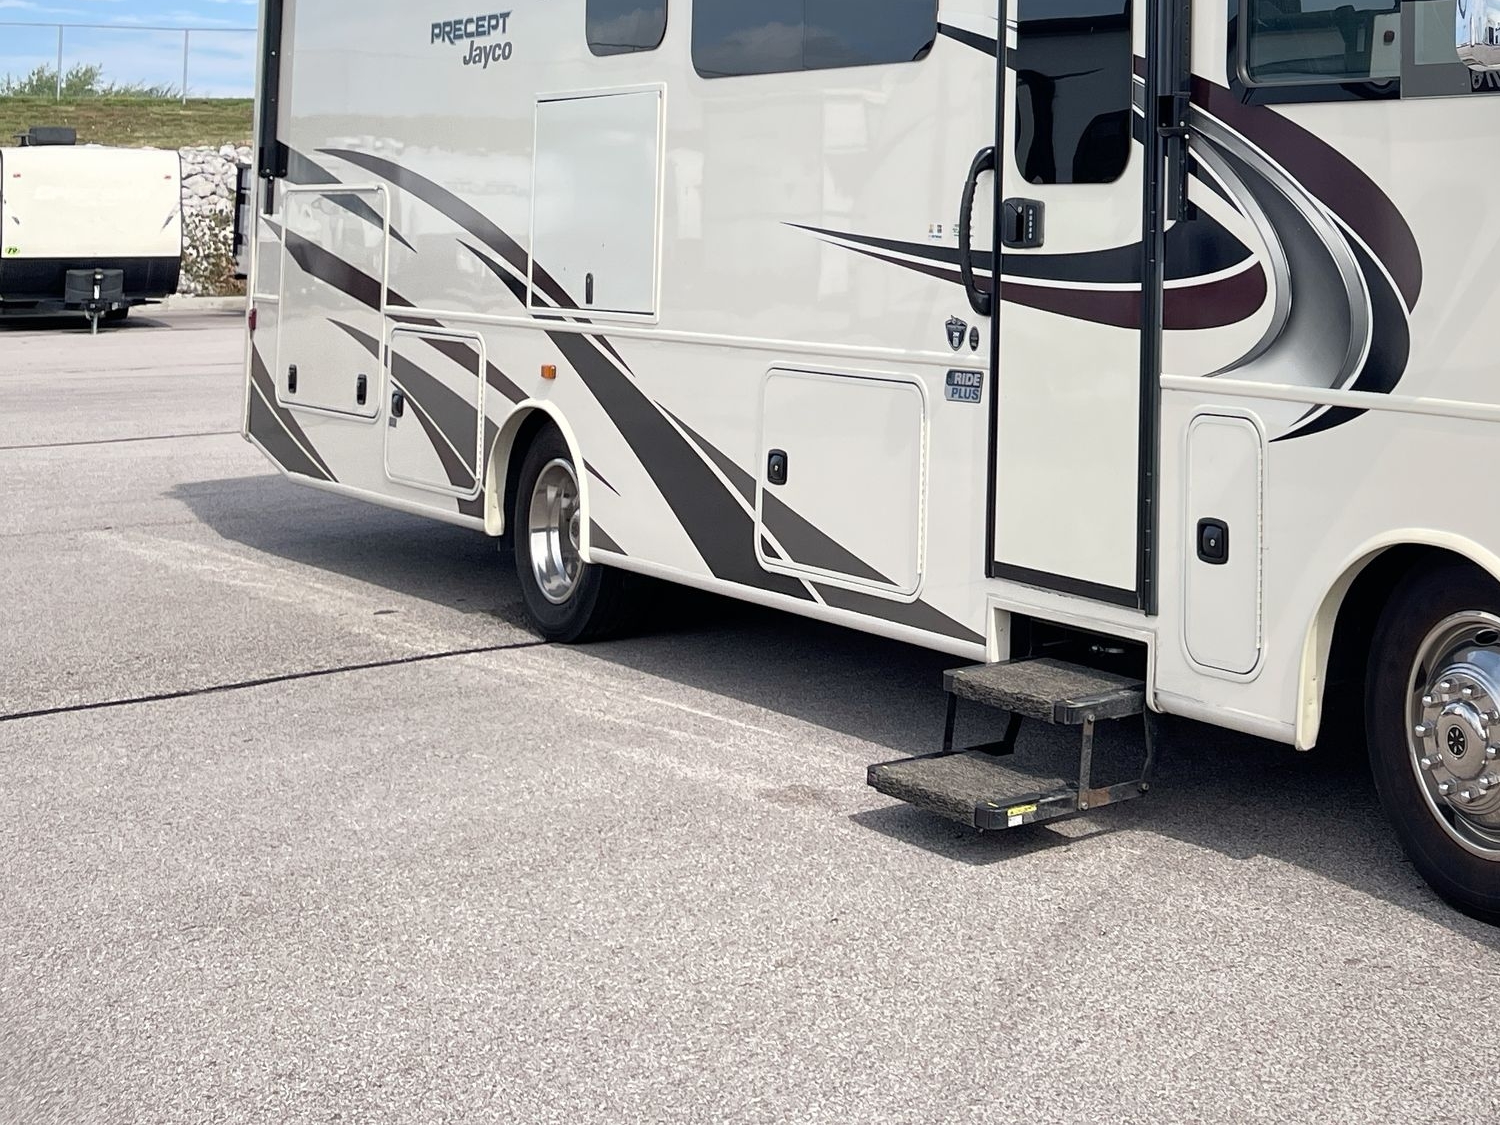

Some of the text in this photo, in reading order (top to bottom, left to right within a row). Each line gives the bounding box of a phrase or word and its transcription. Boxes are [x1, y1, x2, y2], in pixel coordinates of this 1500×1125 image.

[430, 10, 513, 45] PRECEPT
[463, 40, 513, 69] Jayco
[951, 387, 979, 400] PLUS
